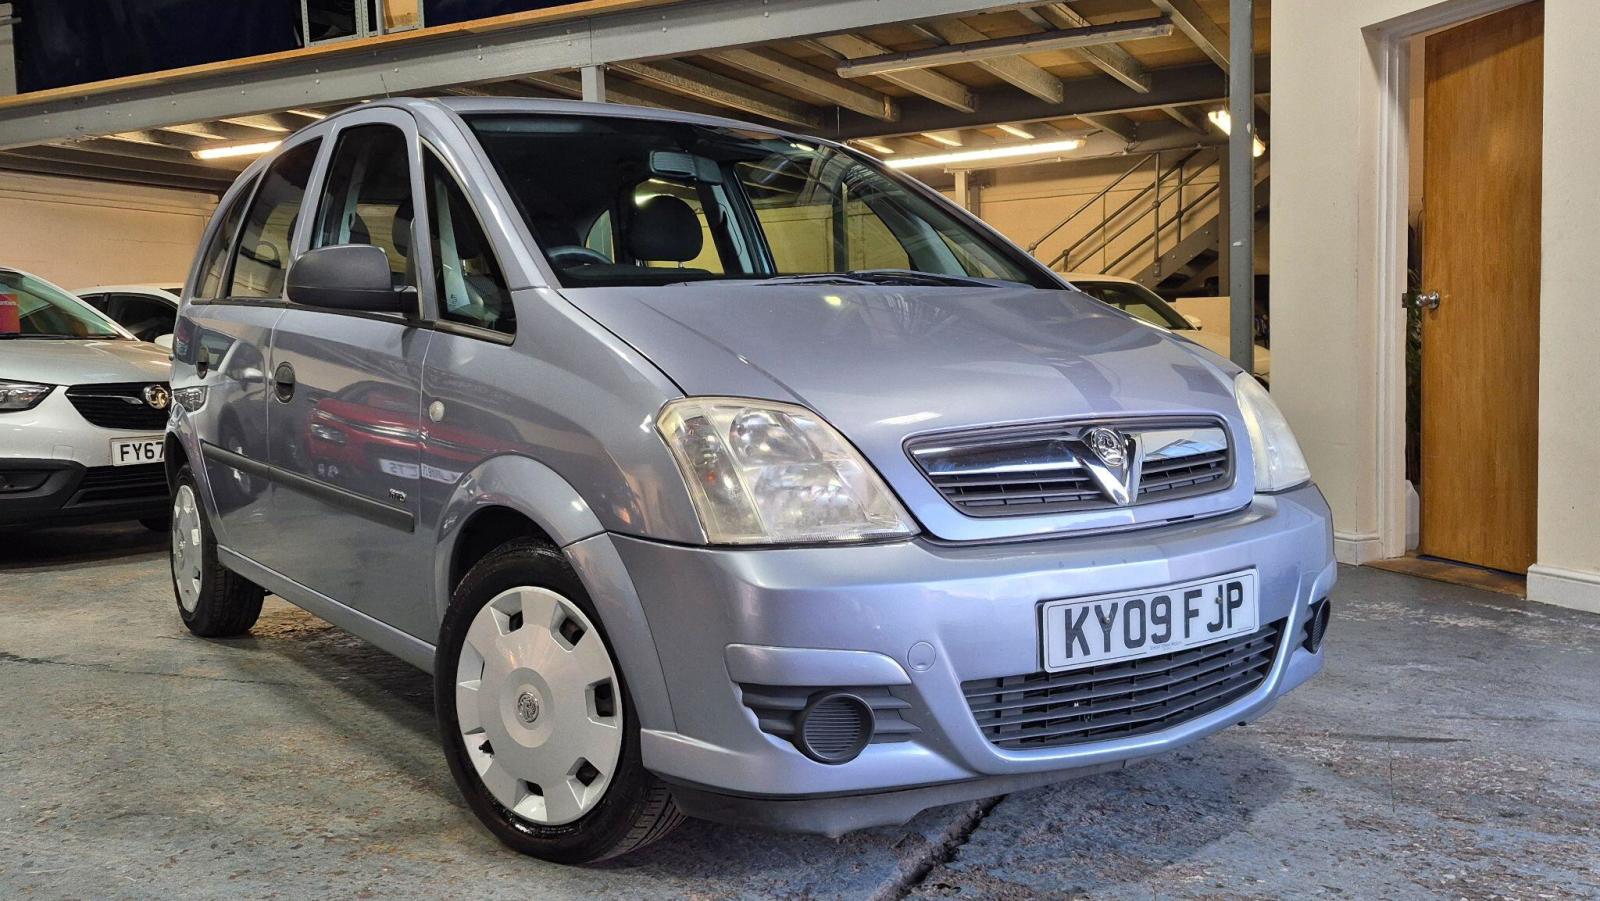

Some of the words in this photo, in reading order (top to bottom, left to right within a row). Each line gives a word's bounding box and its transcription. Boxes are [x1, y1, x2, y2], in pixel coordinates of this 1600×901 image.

[120, 441, 164, 462] FY67
[1064, 595, 1172, 659] KY09
[1183, 580, 1244, 639] FJP
